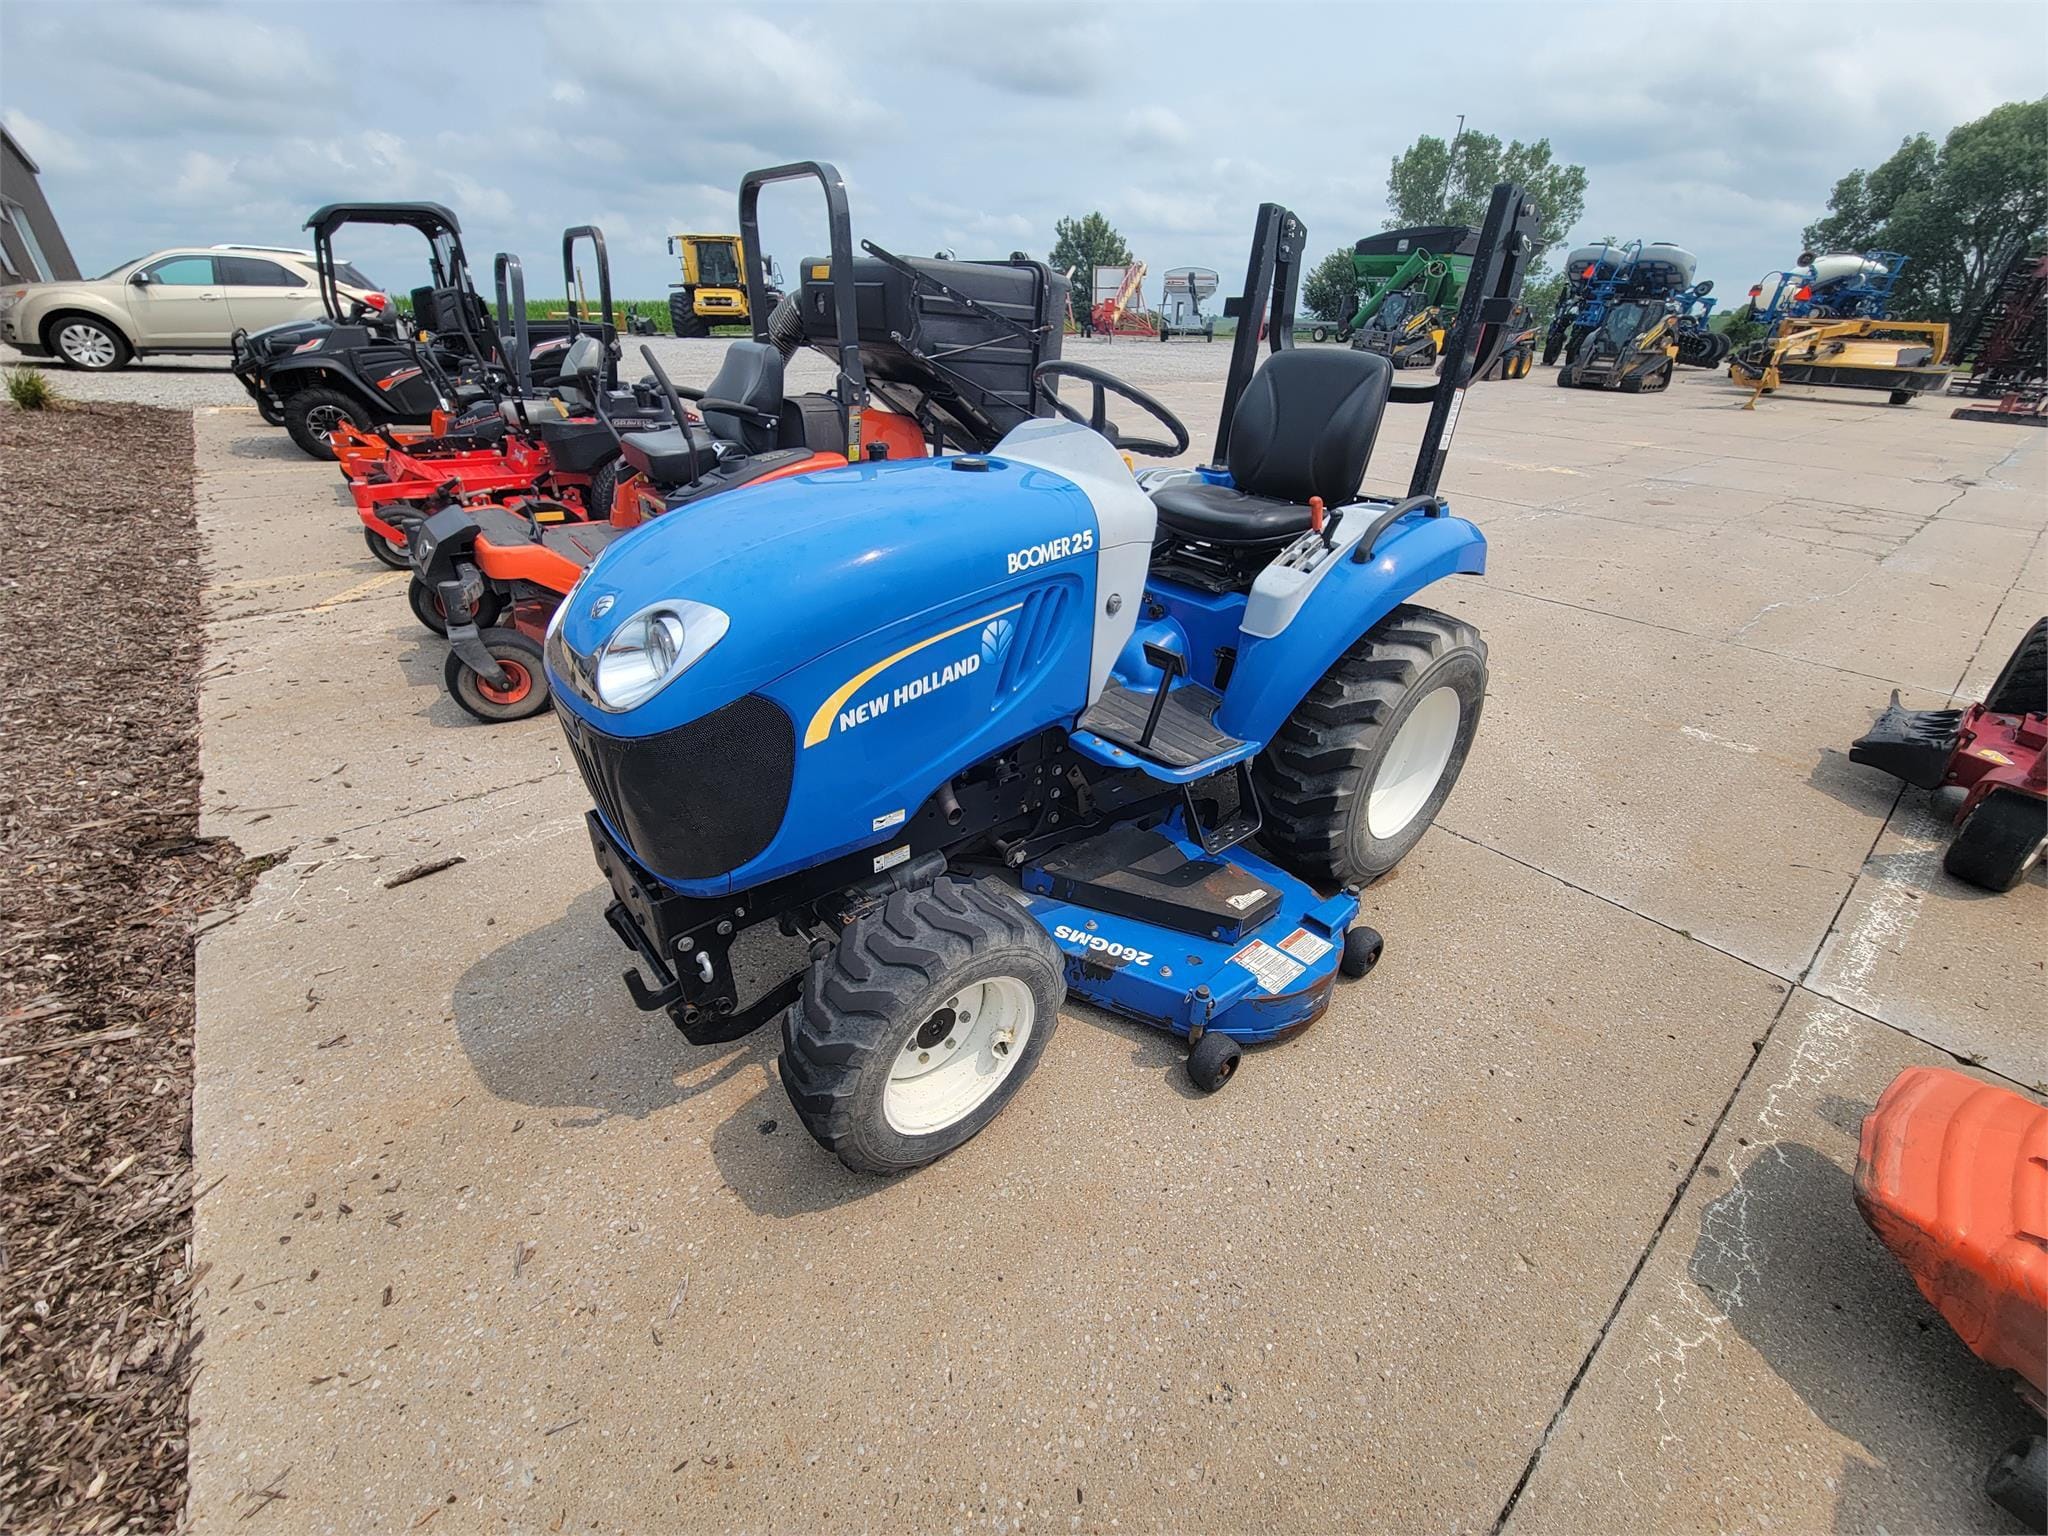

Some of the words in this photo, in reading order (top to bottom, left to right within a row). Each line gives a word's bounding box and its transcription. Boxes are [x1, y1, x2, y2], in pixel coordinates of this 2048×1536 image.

[839, 693, 890, 733] NEW
[893, 653, 981, 709] HOLLAND
[1053, 925, 1154, 966] 260GMS
